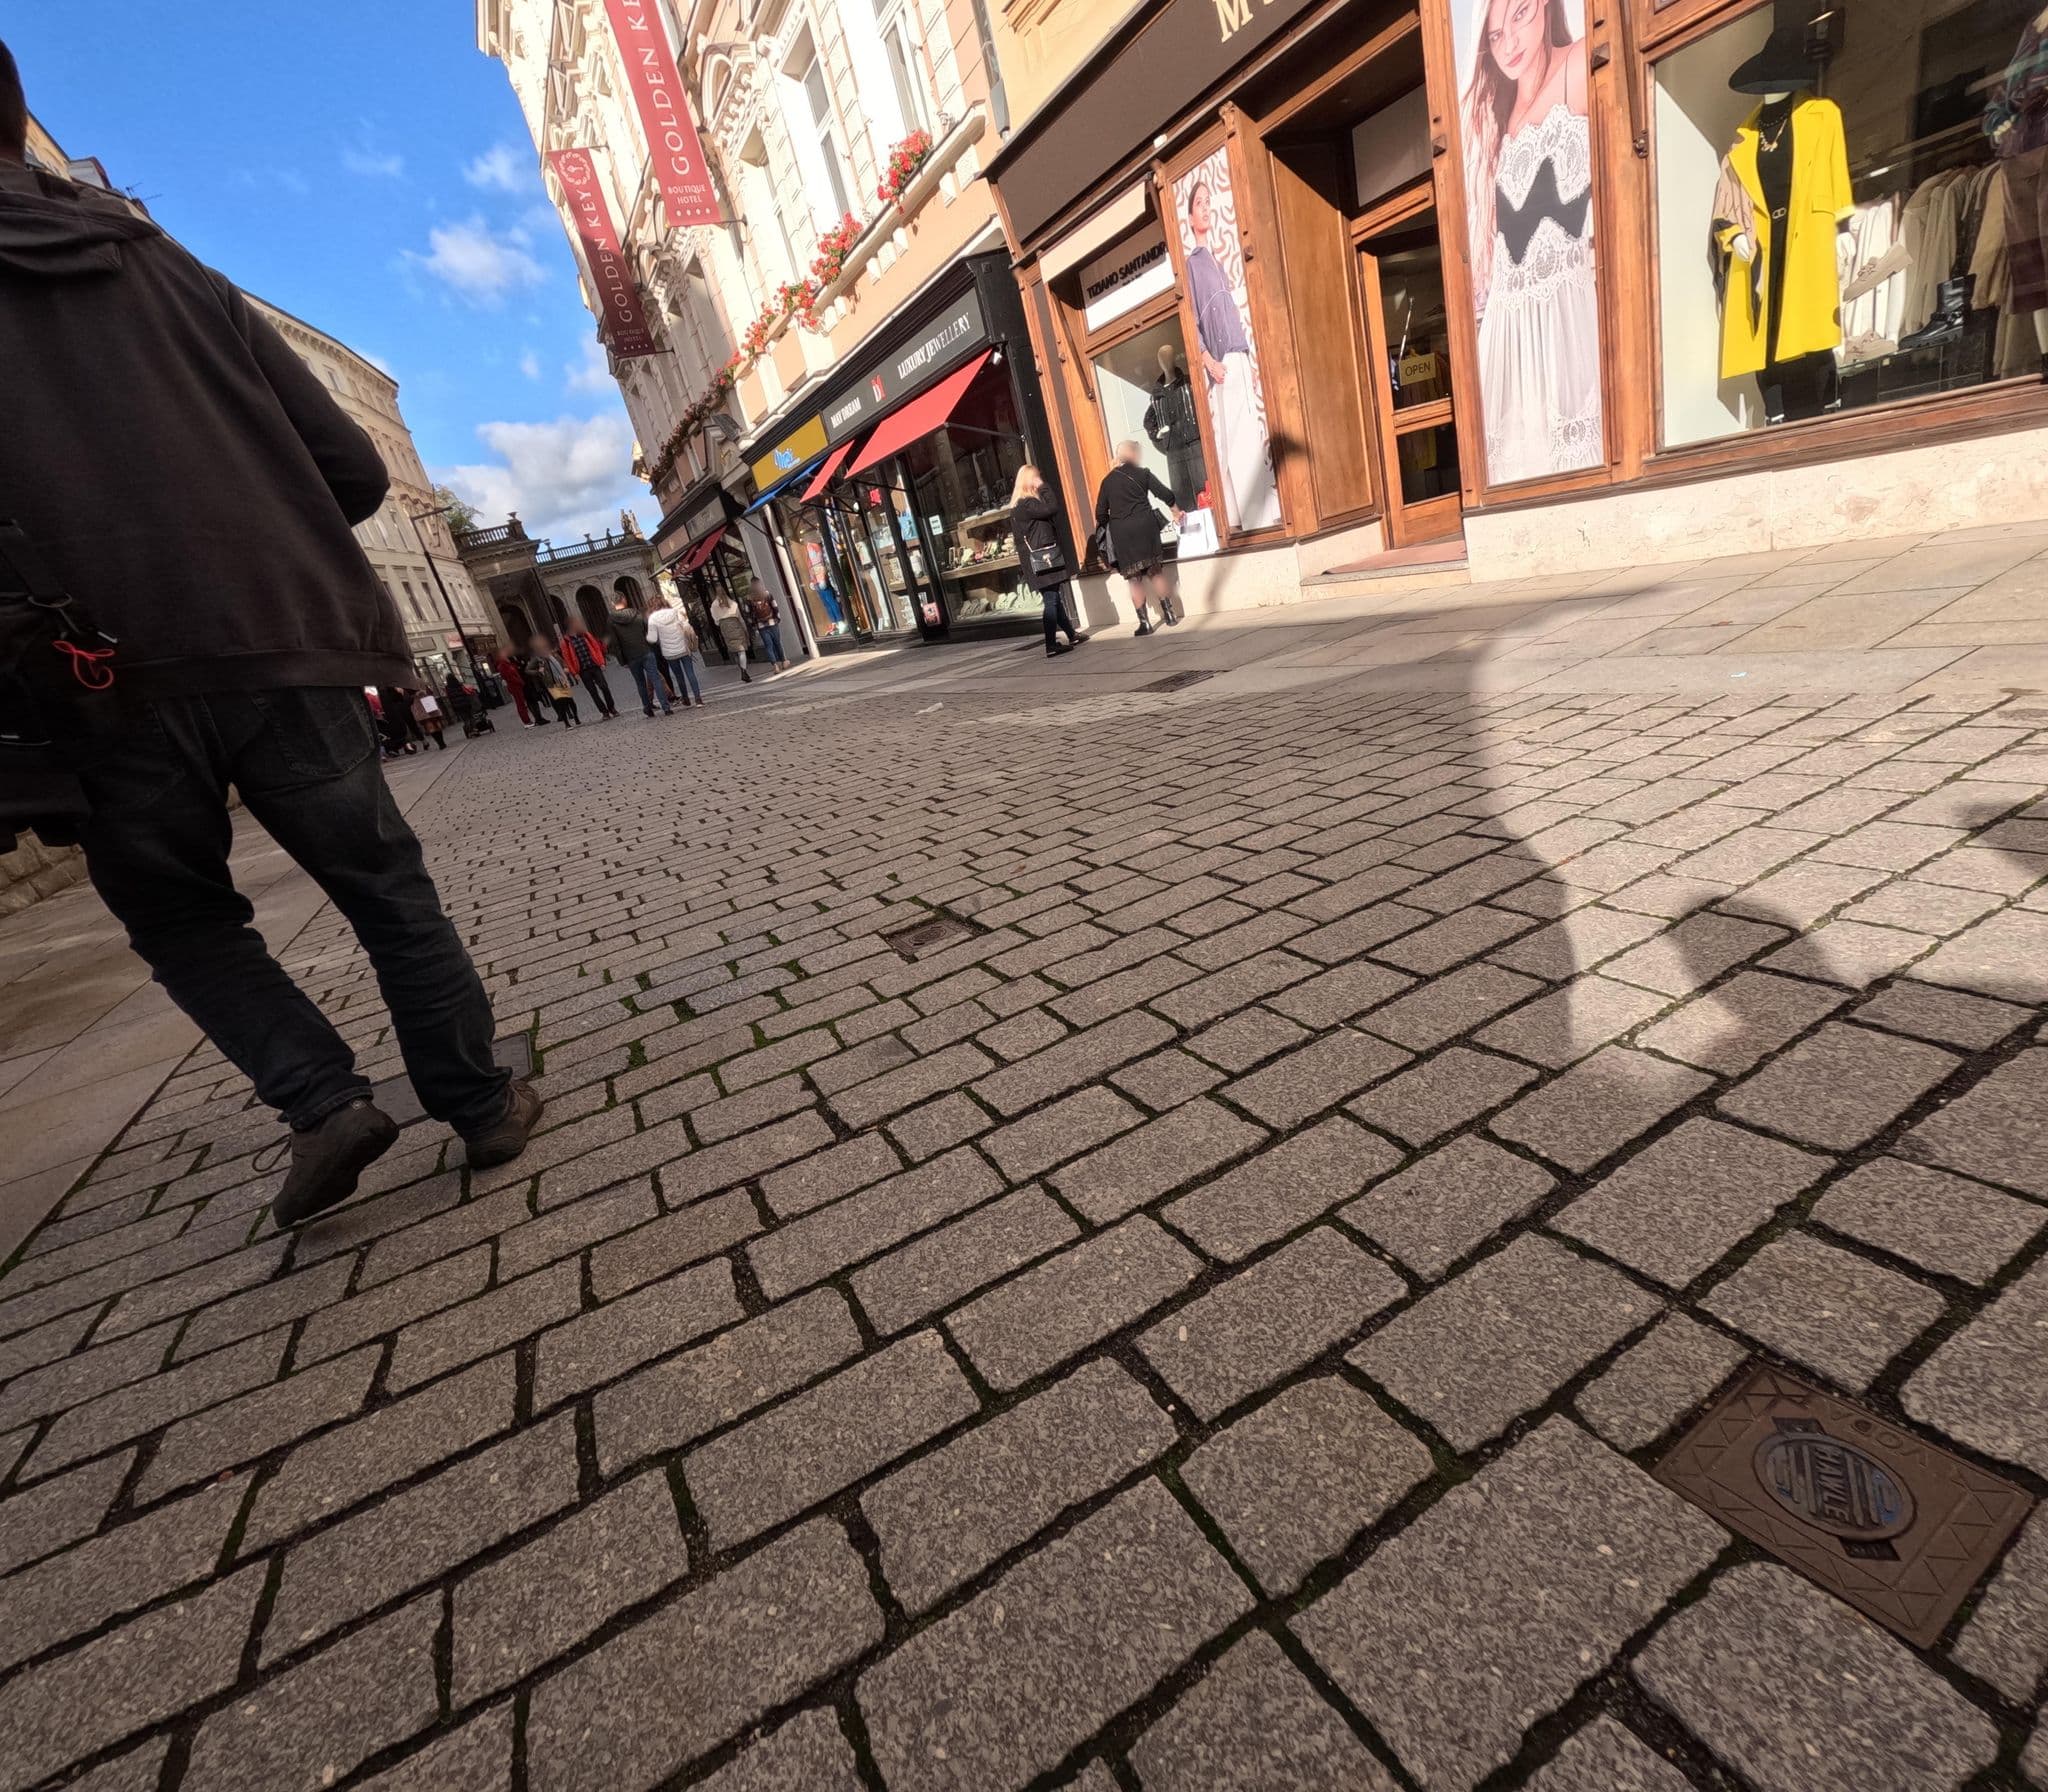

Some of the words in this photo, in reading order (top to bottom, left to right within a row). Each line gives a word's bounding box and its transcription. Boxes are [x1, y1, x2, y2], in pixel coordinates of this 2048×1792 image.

[638, 47, 690, 175] GOLDEN
[667, 183, 706, 195] BOUTIQUE
[677, 195, 702, 205] HOTEL
[576, 190, 601, 228] KEY
[594, 238, 633, 323] GOLDEN
[1087, 271, 1119, 299] TIZIANO
[897, 346, 926, 380] LUXURY
[925, 312, 970, 363] JEWELLERY
[1405, 361, 1431, 377] OPEN
[1814, 1447, 1851, 1522] HAWLE
